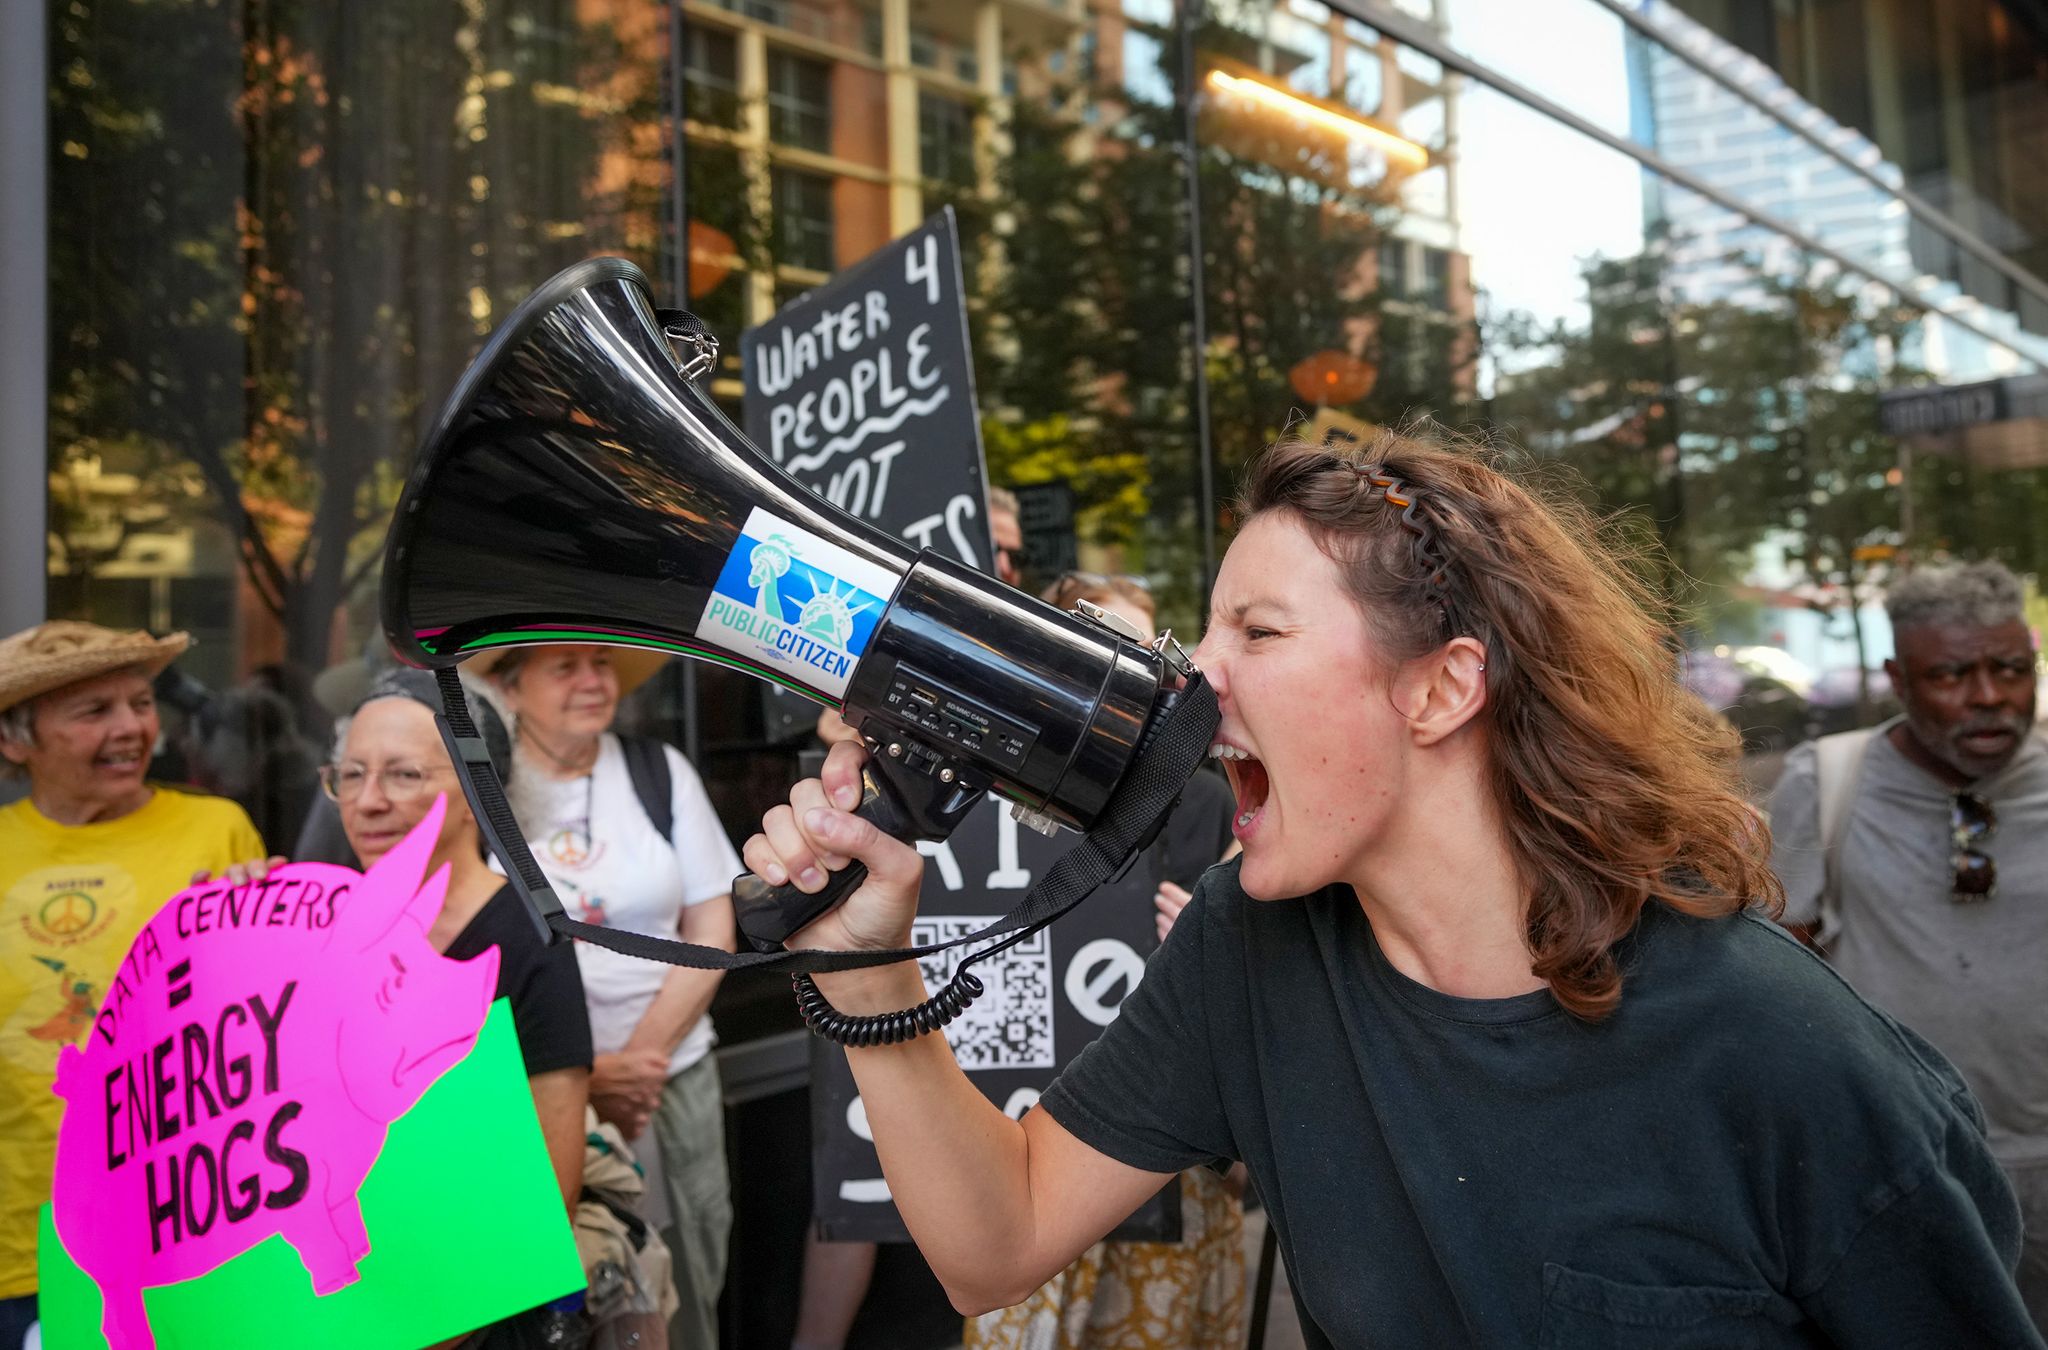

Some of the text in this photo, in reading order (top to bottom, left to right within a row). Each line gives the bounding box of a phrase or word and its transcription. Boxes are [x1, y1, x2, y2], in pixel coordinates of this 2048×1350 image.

[756, 234, 940, 397] WATER 4
[770, 323, 943, 463] PEOPLE
[888, 692, 901, 705] BT
[900, 709, 919, 722] MODE
[970, 713, 989, 726] CARD
[907, 742, 944, 763] ON OFF
[1006, 745, 1020, 757] LED
[1010, 737, 1024, 749] AUX
[98, 926, 162, 1046] DATA
[176, 879, 349, 938] CENTERS
[105, 980, 298, 1171] ENERGY
[145, 1101, 310, 1254] HOGS
